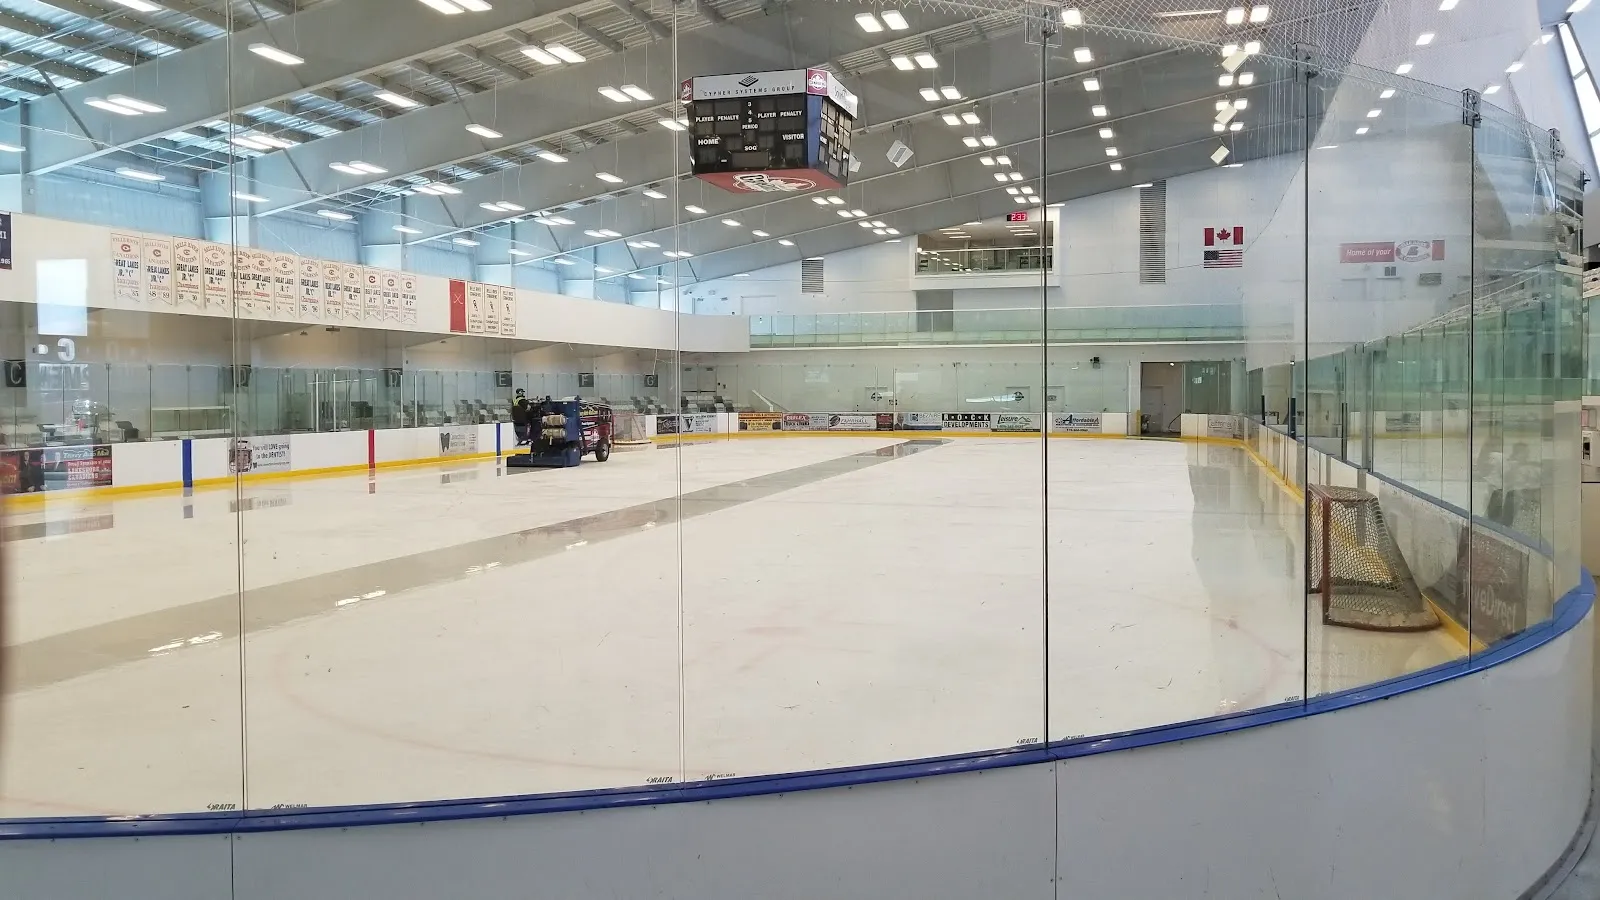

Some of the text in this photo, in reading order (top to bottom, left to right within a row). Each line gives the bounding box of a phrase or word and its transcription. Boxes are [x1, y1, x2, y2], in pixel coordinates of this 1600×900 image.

[735, 87, 768, 95] SYSTEMS
[697, 137, 720, 145] HOME
[782, 133, 805, 141] VISITOR
[1346, 249, 1366, 257] Home
[1367, 248, 1375, 257] of
[1375, 248, 1392, 257] your
[176, 263, 199, 274] GREAT LAKES
[204, 267, 226, 277] GREAT LAKES
[997, 414, 1019, 425] Leisure
[944, 421, 989, 429] DEVELOPMENTS
